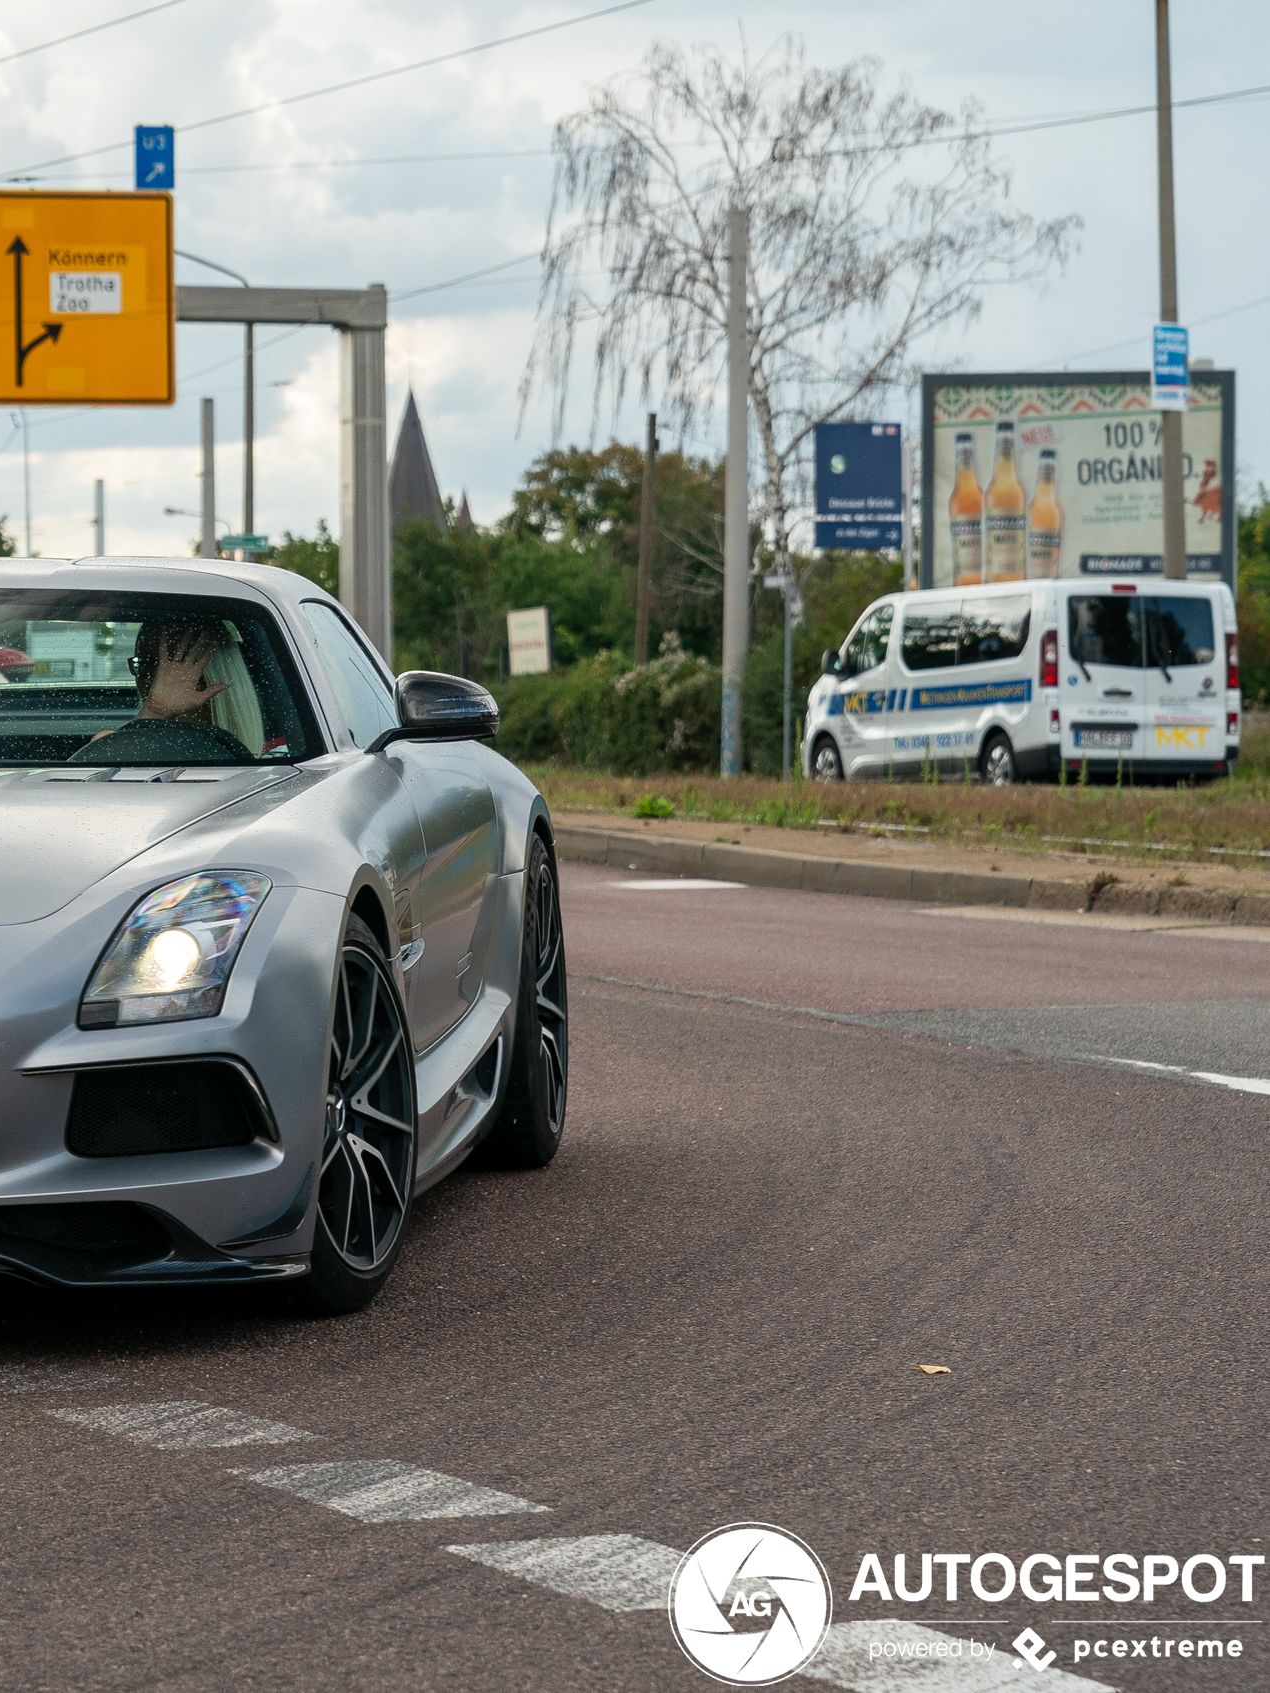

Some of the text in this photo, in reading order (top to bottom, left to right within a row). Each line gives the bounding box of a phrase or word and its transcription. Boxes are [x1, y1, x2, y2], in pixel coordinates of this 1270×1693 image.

[142, 134, 166, 150] U3
[49, 247, 127, 266] Könnern
[57, 275, 115, 292] Trotha
[56, 293, 89, 311] Zoo
[1103, 421, 1144, 449] 100
[1077, 450, 1200, 486] ORGÁNIO.
[1087, 557, 1143, 571] BIONADE
[844, 692, 868, 714] MKT
[1156, 725, 1210, 748] MKT
